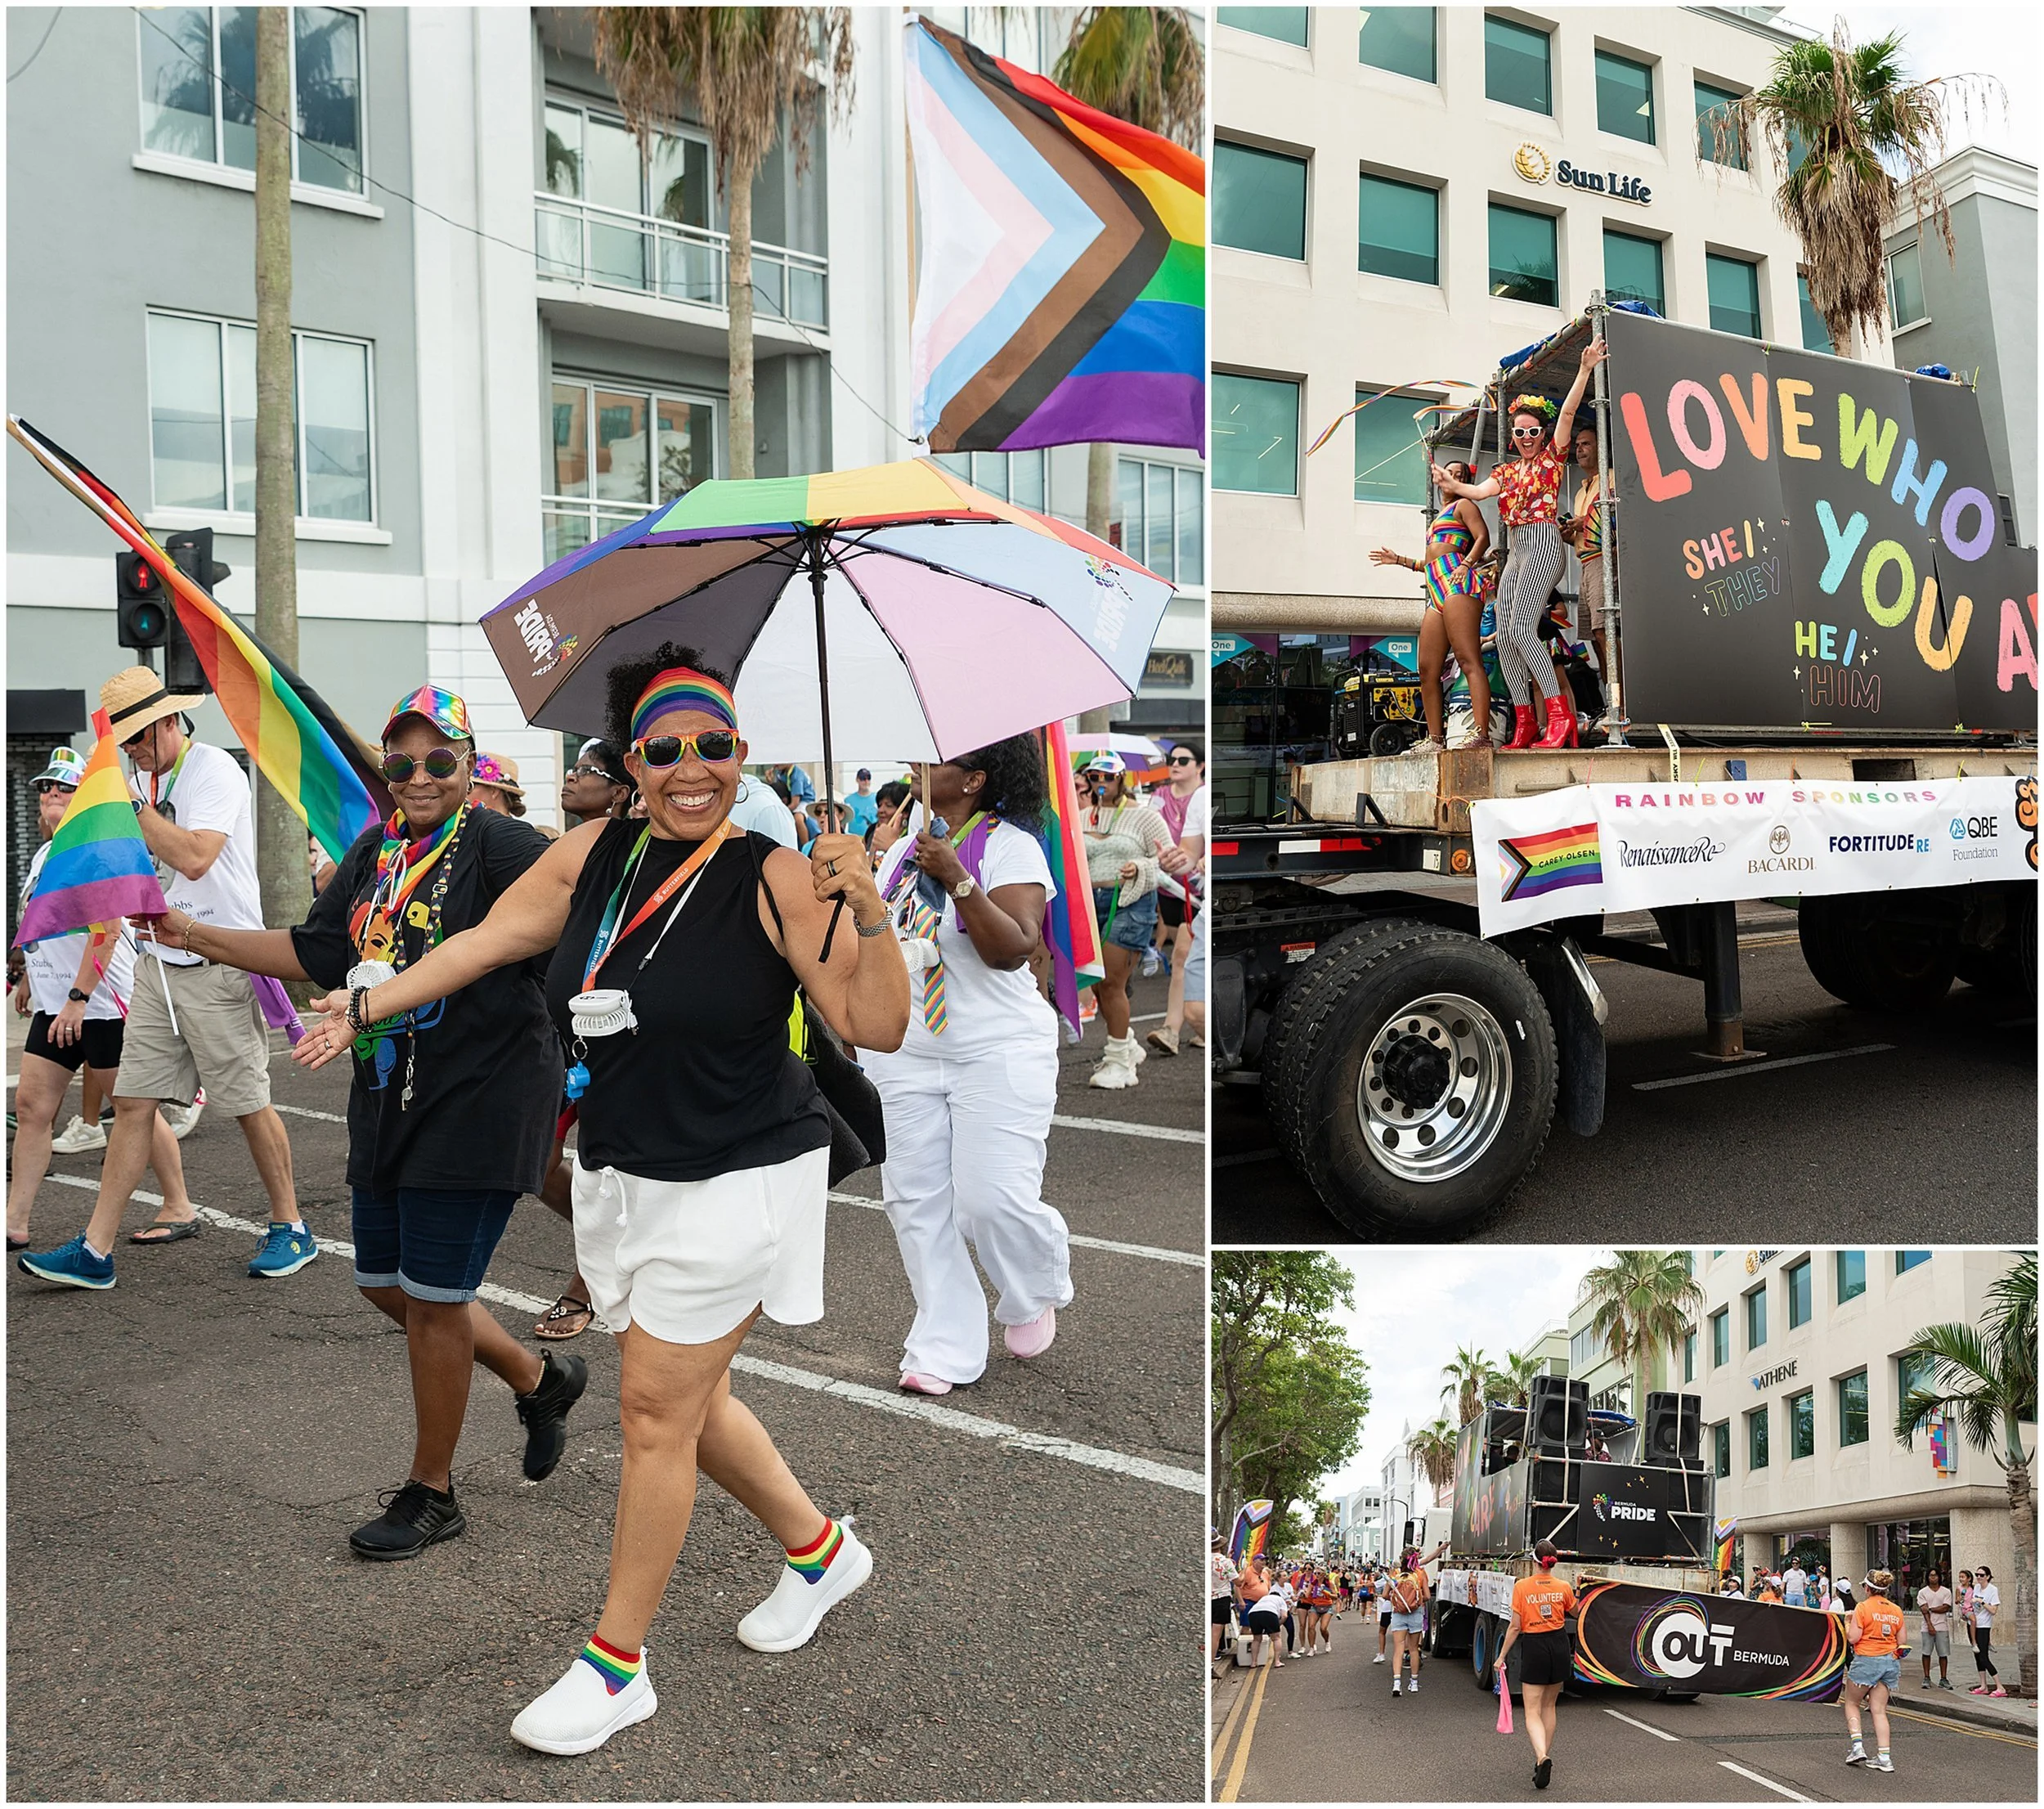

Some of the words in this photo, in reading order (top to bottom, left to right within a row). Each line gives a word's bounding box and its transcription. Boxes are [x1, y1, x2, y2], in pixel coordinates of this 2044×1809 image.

[1558, 159, 1605, 192] Sun
[1607, 172, 1652, 204] Life
[1620, 372, 1822, 502] LOVE
[1838, 392, 1995, 562] WHO
[1704, 556, 1781, 617] THEY
[1814, 499, 1974, 671] YOU
[1212, 641, 1231, 649] One
[1997, 592, 2037, 693] A
[1809, 665, 1881, 714] HIM
[1615, 791, 1765, 808] RAINBOW
[1791, 791, 1937, 804] SPONSORS
[1967, 816, 1998, 839] QBE
[1617, 836, 1727, 868] RenaissanceRe
[1829, 833, 1914, 853] FORTITUDE
[1916, 838, 1930, 854] RE
[1953, 846, 1998, 861] Foundation
[1538, 855, 1563, 869] CAREY
[1566, 849, 1595, 861] OLSEN
[1748, 857, 1815, 874] BACARDI
[661, 867, 689, 896] BUTTERFIELD
[196, 909, 214, 918] 1994
[1758, 1360, 1798, 1391] ATHENE
[1611, 1506, 1656, 1522] PRIDE
[1525, 1592, 1564, 1604] VOLUNTEER
[1871, 1612, 1900, 1626] VOLUNTEER
[1662, 1623, 1735, 1667] OUT
[1733, 1650, 1790, 1667] BERMUDA
